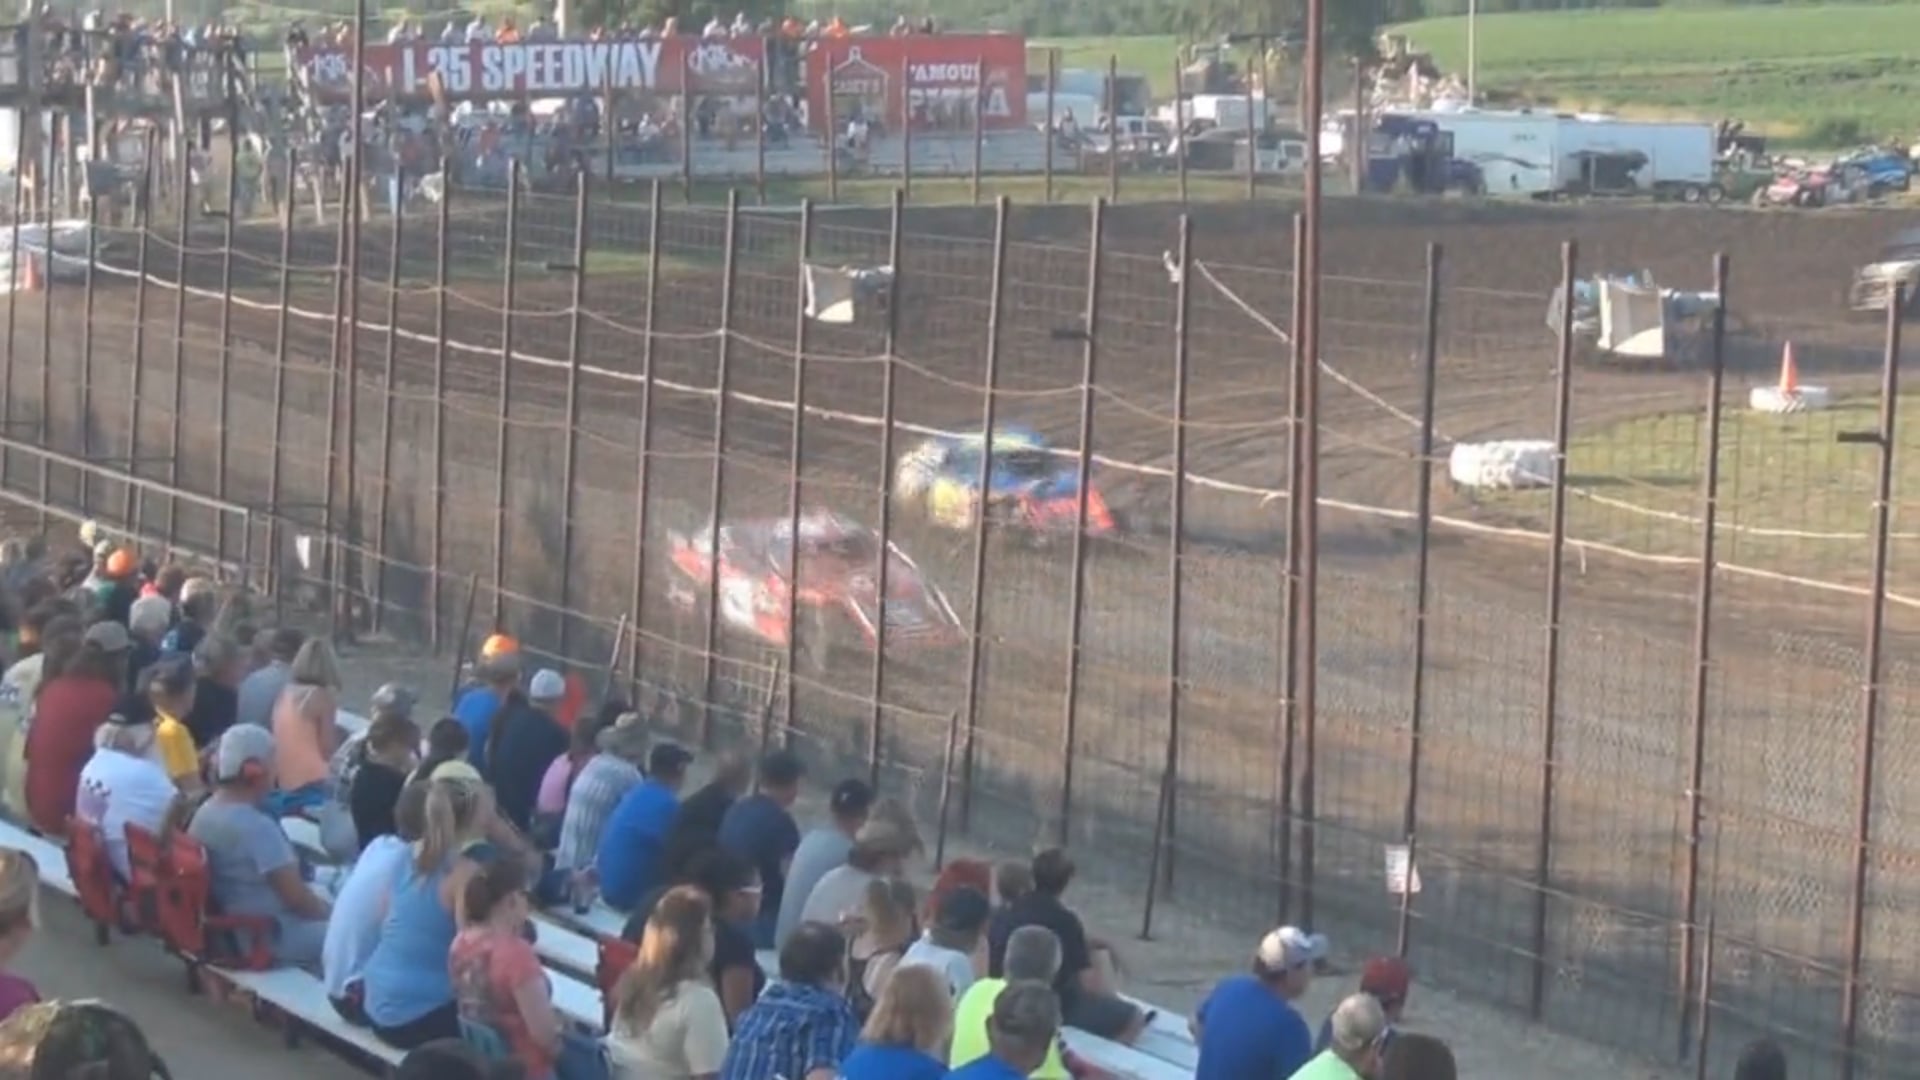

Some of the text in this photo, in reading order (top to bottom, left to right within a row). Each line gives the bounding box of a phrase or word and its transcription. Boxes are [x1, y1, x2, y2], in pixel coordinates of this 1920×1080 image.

[403, 47, 472, 92] I-35
[482, 43, 662, 91] SPEEDWAY
[909, 63, 981, 81] AMOU
